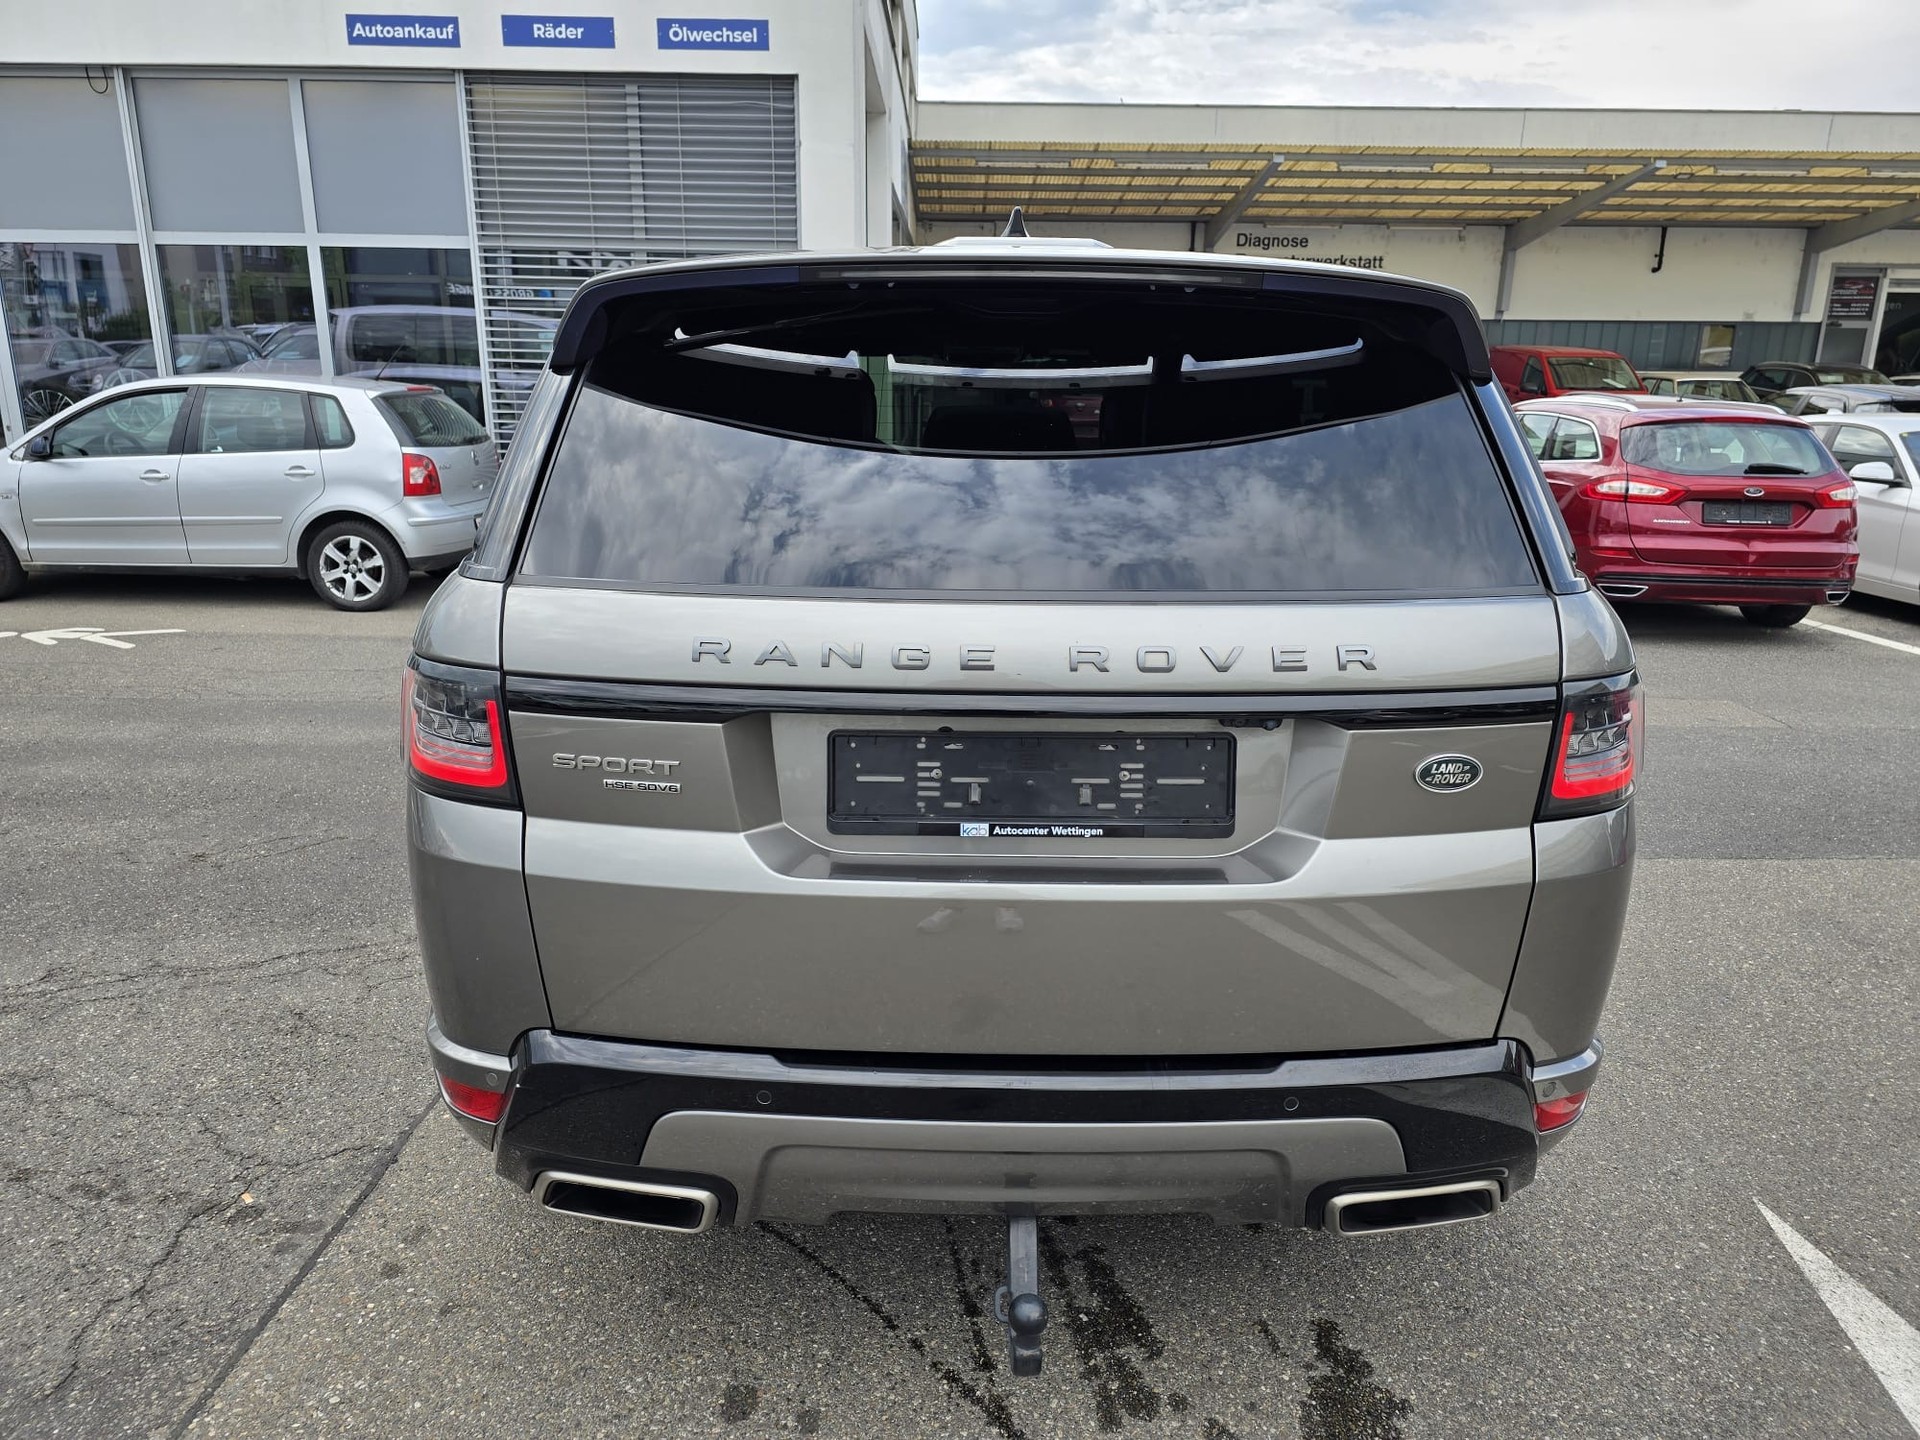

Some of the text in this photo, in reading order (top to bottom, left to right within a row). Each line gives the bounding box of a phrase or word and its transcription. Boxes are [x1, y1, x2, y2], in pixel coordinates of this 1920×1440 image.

[352, 22, 455, 40] Autoankauf
[533, 23, 584, 39] Räder
[668, 24, 758, 43] Ölwechsel
[1236, 232, 1309, 250] Diagnose
[691, 636, 1378, 673] RANGE ROVER
[552, 752, 680, 776] SPORT
[1431, 763, 1464, 774] LAND
[604, 780, 679, 793] HSE SDV6
[1431, 773, 1472, 784] ROVER
[993, 825, 1049, 836] Autocenter
[1051, 826, 1104, 838] Wettingen
